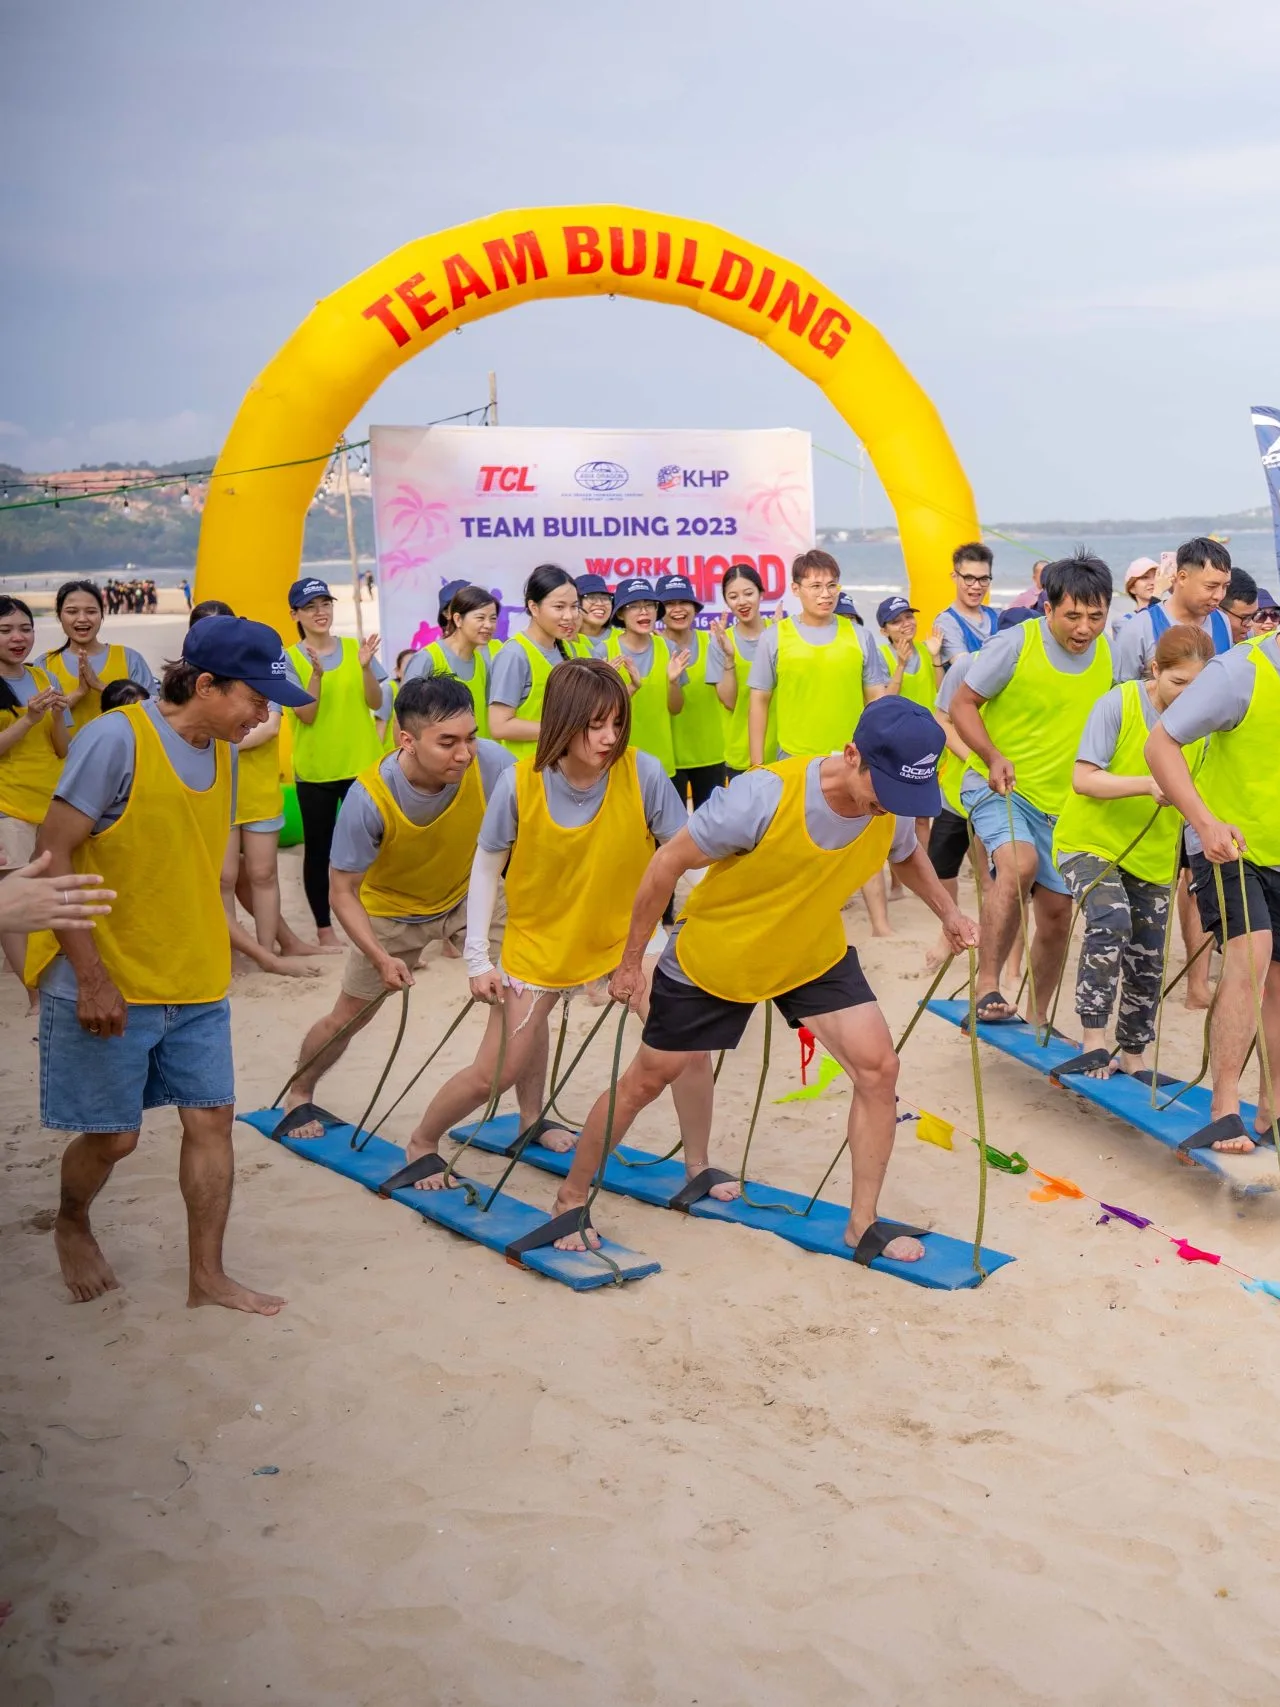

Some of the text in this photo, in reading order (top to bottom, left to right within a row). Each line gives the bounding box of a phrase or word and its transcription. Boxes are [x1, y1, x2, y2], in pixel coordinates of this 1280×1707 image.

[362, 226, 851, 359] TEAM BUILDING
[479, 465, 537, 492] TCL
[682, 469, 729, 488] KHP
[460, 516, 737, 538] TEAM BUILDING 2023
[584, 557, 673, 578] WORK
